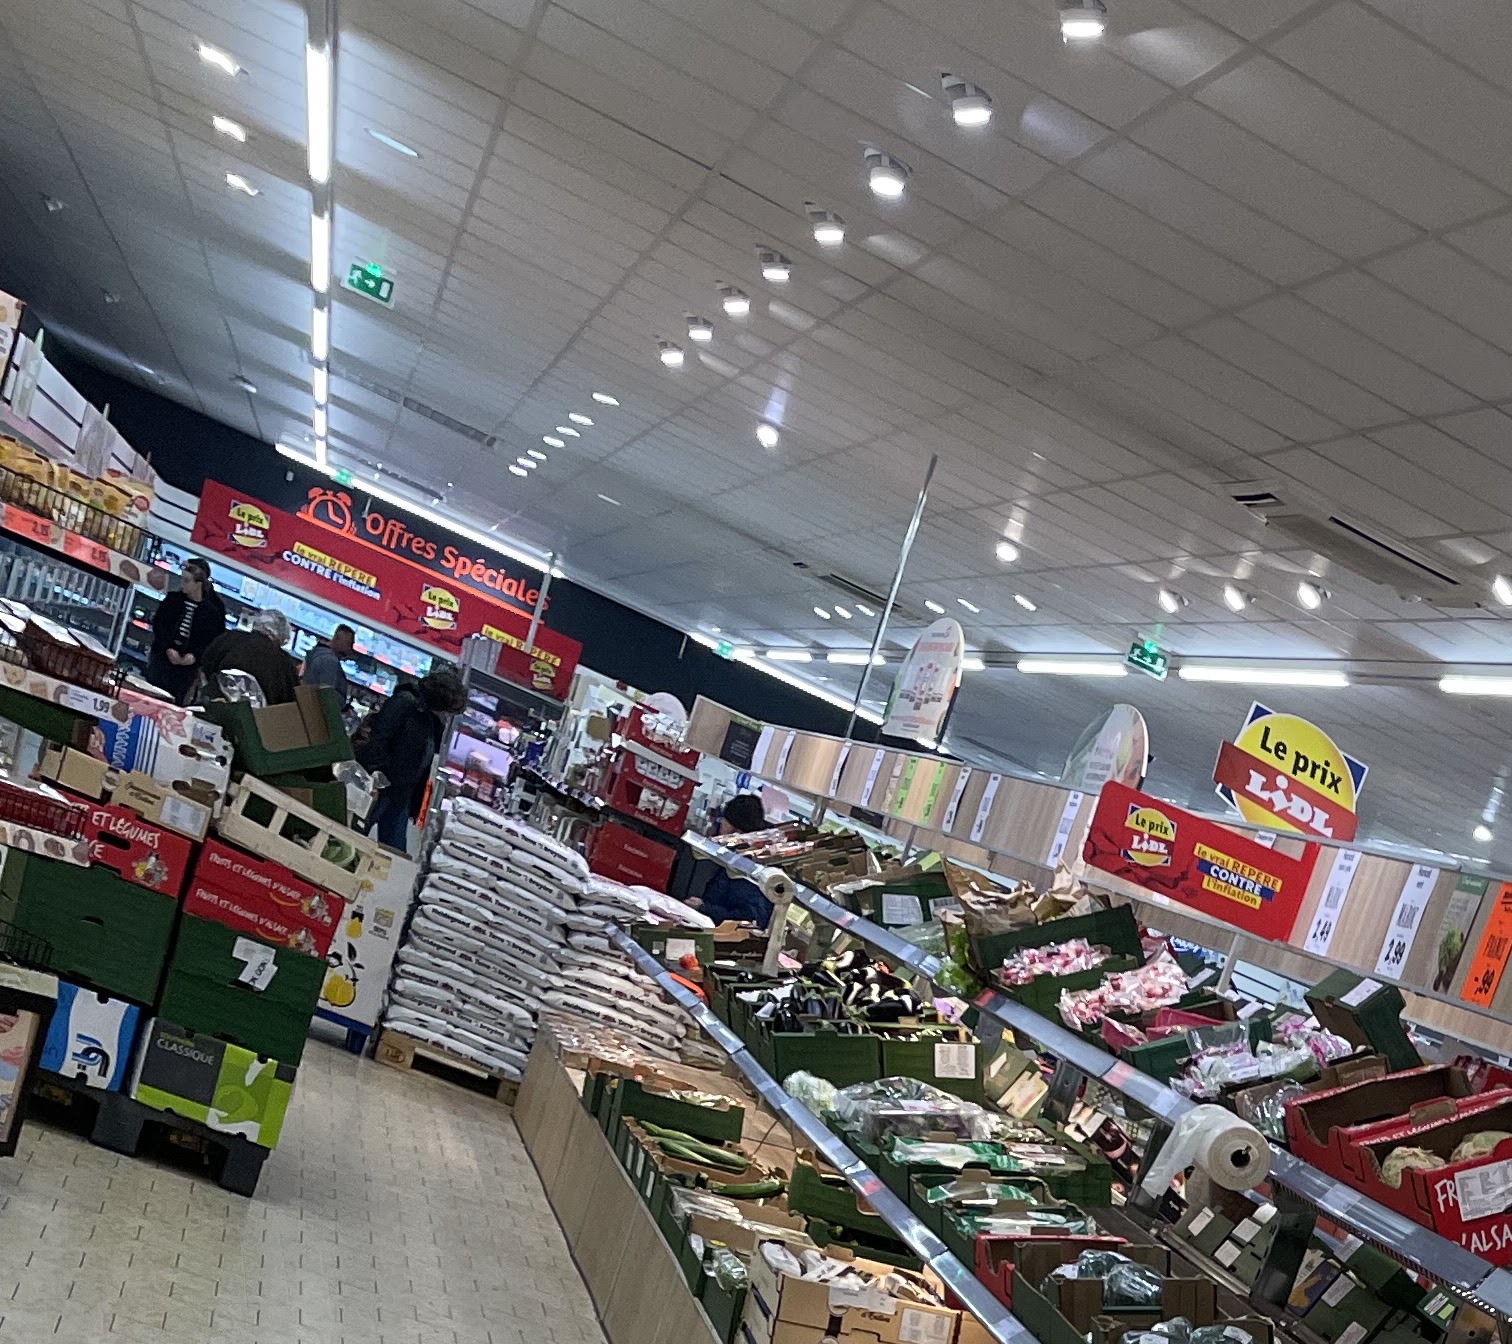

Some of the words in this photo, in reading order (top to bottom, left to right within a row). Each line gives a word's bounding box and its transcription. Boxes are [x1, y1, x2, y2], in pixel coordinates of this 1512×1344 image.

[283, 551, 332, 581] CONTRE
[366, 512, 436, 559] Offres
[439, 546, 551, 611] Spéciales
[1260, 726, 1288, 761] Le
[1293, 749, 1343, 794] prix
[92, 811, 107, 828] ET
[107, 815, 160, 849] LÉGUMES
[1135, 813, 1149, 830] Le
[1148, 819, 1170, 838] prix
[1196, 846, 1207, 859] le
[1208, 849, 1231, 868] vrai
[1206, 878, 1259, 908] l'inflation
[1210, 866, 1262, 896] CONTRE
[157, 1038, 215, 1066] CLASSIQUE
